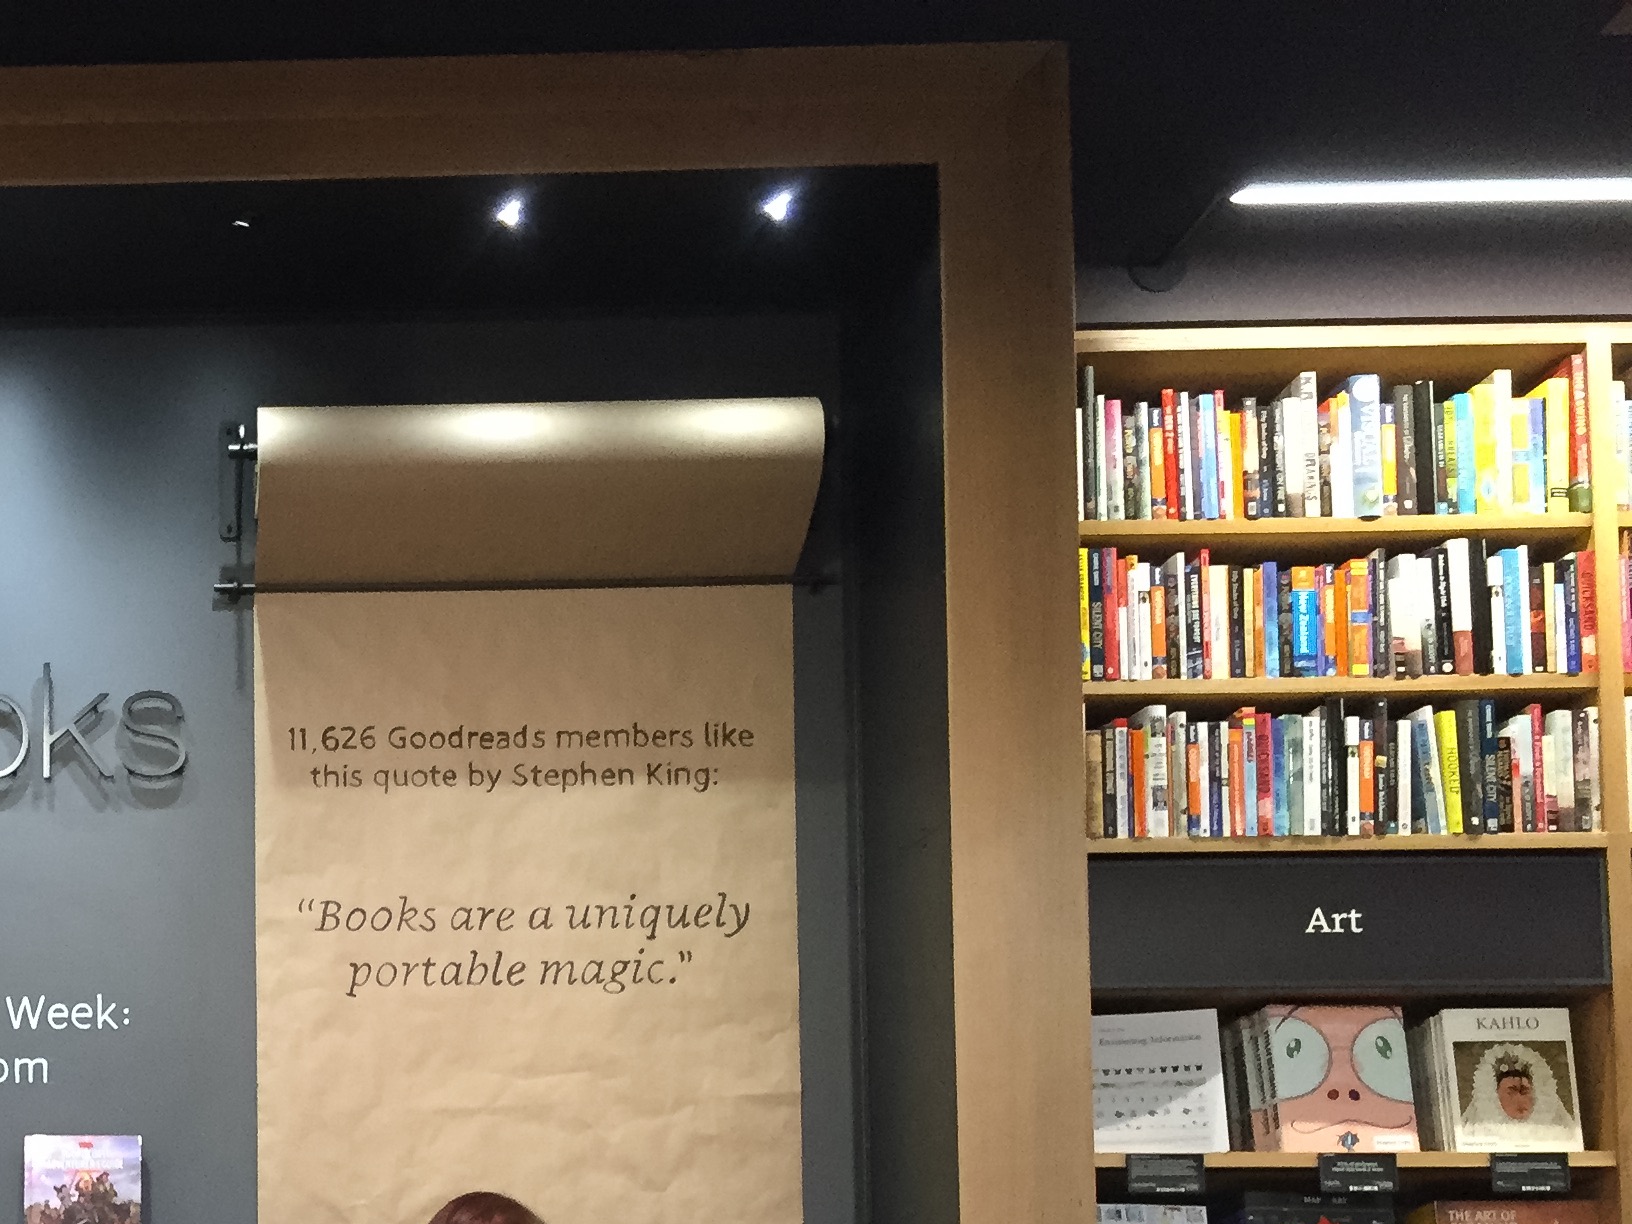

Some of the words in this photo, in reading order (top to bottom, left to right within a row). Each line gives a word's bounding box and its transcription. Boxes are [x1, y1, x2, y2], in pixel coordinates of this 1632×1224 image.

[1092, 602, 1102, 629] SILENT
[1298, 592, 1308, 613] New
[1093, 632, 1102, 649] CITY
[1299, 614, 1309, 653] Zealand
[287, 724, 378, 756] 11,626
[387, 724, 547, 752] Goodreads
[555, 721, 695, 751] members
[702, 720, 756, 749] like
[310, 763, 364, 789] this
[372, 765, 458, 796] quote
[467, 762, 502, 794] by
[511, 762, 636, 794] Stephen
[645, 762, 721, 793] King:
[1447, 747, 1460, 795] HOOKED
[1486, 755, 1496, 783] SILENT
[1486, 784, 1497, 802] CITY
[449, 903, 516, 933] are
[527, 904, 555, 932] a
[565, 892, 752, 941] uniquely
[1304, 907, 1364, 934] Art
[344, 950, 528, 998] portable
[4, 993, 133, 1032] Week:
[1475, 1015, 1541, 1033] KAHLO
[1448, 1210, 1466, 1222] THE
[1470, 1210, 1491, 1223] ART
[1497, 1209, 1517, 1222] OF
